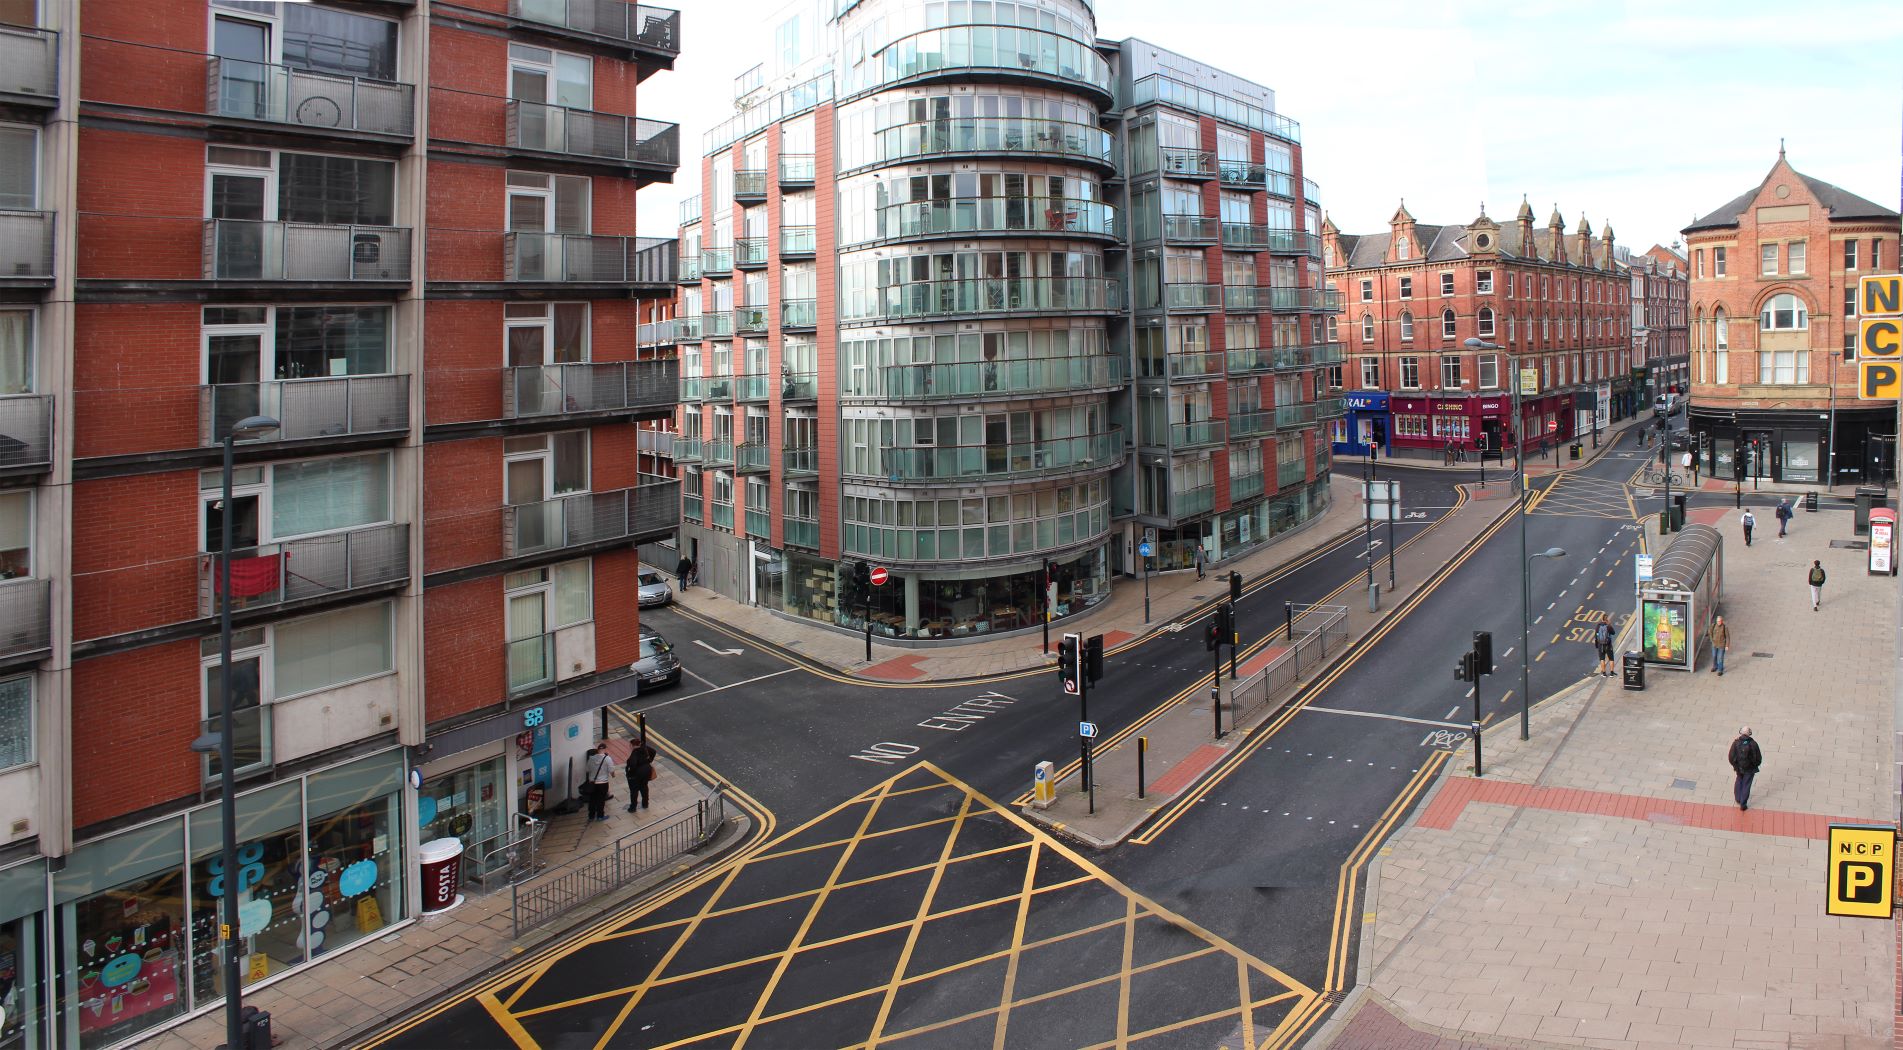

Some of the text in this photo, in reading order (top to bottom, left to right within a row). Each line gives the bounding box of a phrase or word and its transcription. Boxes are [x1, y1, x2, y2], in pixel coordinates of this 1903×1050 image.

[1865, 279, 1899, 397] NCP
[917, 691, 1019, 731] ENTRY
[1083, 725, 1089, 734] P
[849, 742, 921, 764] NO
[1840, 843, 1882, 855] NCP
[438, 864, 452, 902] COSTA
[1846, 865, 1875, 899] P
